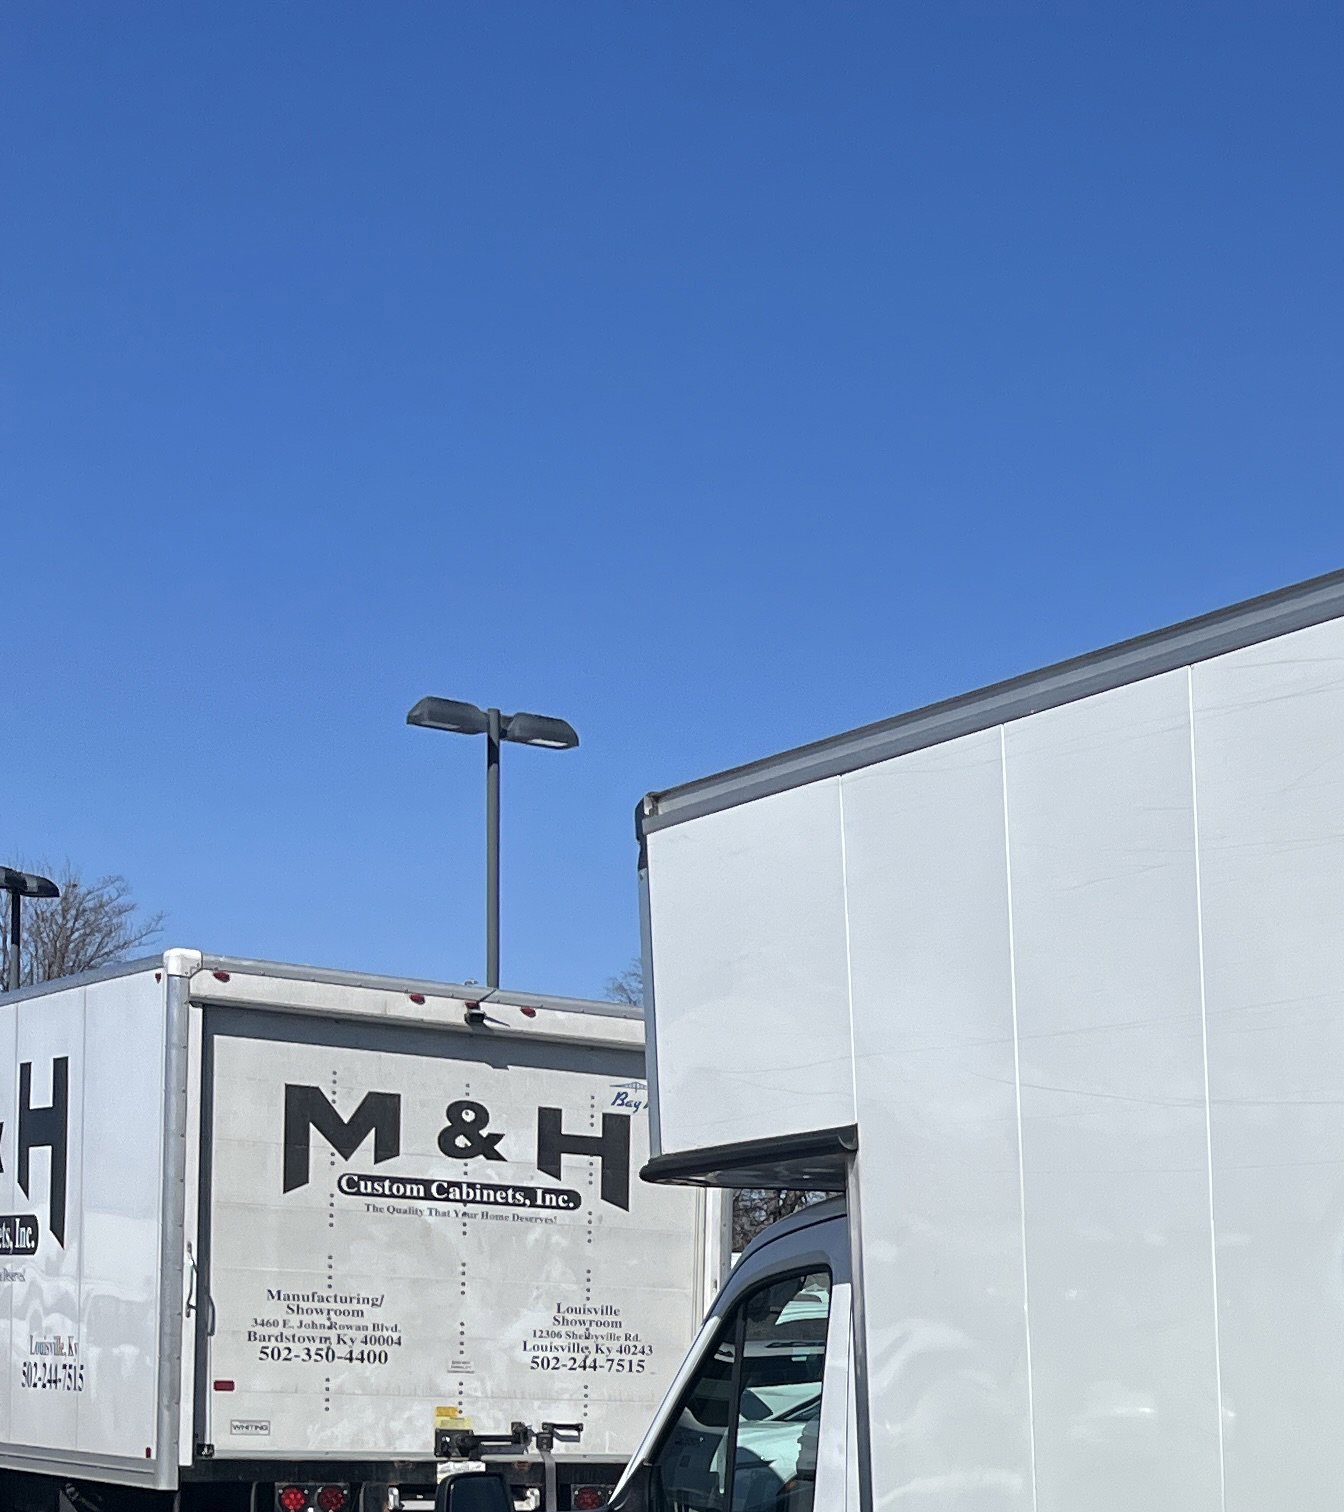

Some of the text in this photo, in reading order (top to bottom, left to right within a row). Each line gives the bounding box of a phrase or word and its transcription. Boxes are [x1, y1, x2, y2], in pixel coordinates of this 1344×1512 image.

[611, 1091, 642, 1113] Bay
[17, 1056, 68, 1249] H
[282, 1083, 631, 1212] M & H
[341, 1174, 576, 1208] Custom Cabinets, Inc.
[364, 1203, 558, 1224] The Quality That Your Home Deserves!
[15, 1217, 35, 1248] Inc.
[266, 1289, 385, 1308] Manufacturing/
[285, 1304, 365, 1318] Showroom
[556, 1302, 621, 1316] Louisville
[251, 1318, 280, 1328] 3460
[297, 1319, 326, 1330] John
[329, 1321, 369, 1332] Rowan
[372, 1323, 402, 1333] Blvd.
[552, 1315, 623, 1328] Showroom
[247, 1331, 402, 1348] Bardstown, Ky 40004
[532, 1329, 642, 1344] 12306 Shelbyville Rd.
[258, 1346, 389, 1365] 502-350-4400
[522, 1340, 654, 1357] Louisville, Ky 40243
[530, 1356, 646, 1374] 502-244-7515
[21, 1361, 84, 1391] 502-244-7515
